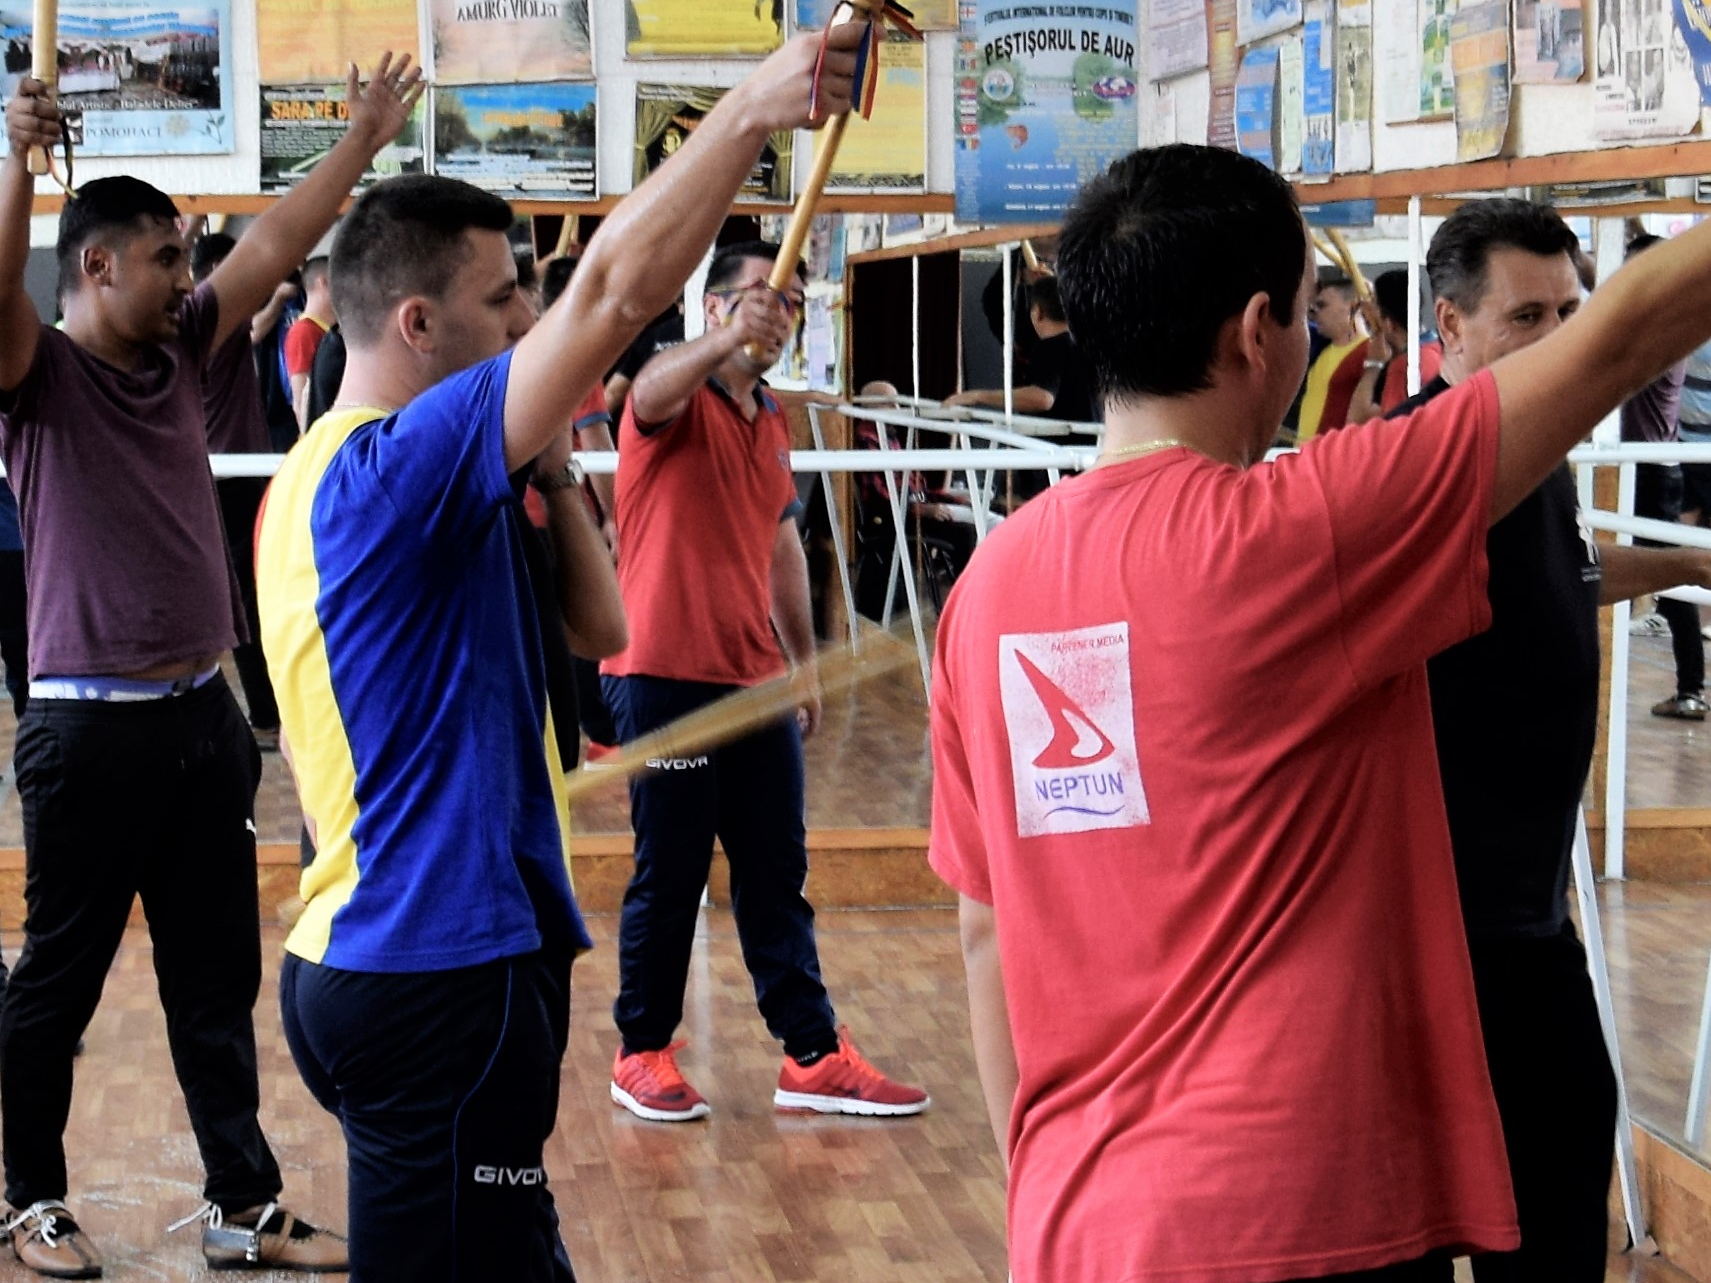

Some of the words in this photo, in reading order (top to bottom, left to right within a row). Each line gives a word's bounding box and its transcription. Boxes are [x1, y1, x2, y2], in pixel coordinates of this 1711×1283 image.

[1081, 30, 1100, 53] DE
[1104, 35, 1134, 68] AUR
[271, 100, 310, 120] SARA
[313, 100, 334, 120] PE
[1097, 634, 1124, 650] MEDIA
[646, 756, 708, 770] GIVOVA
[1035, 772, 1124, 801] NEPTUN
[474, 1165, 542, 1185] GIVO
